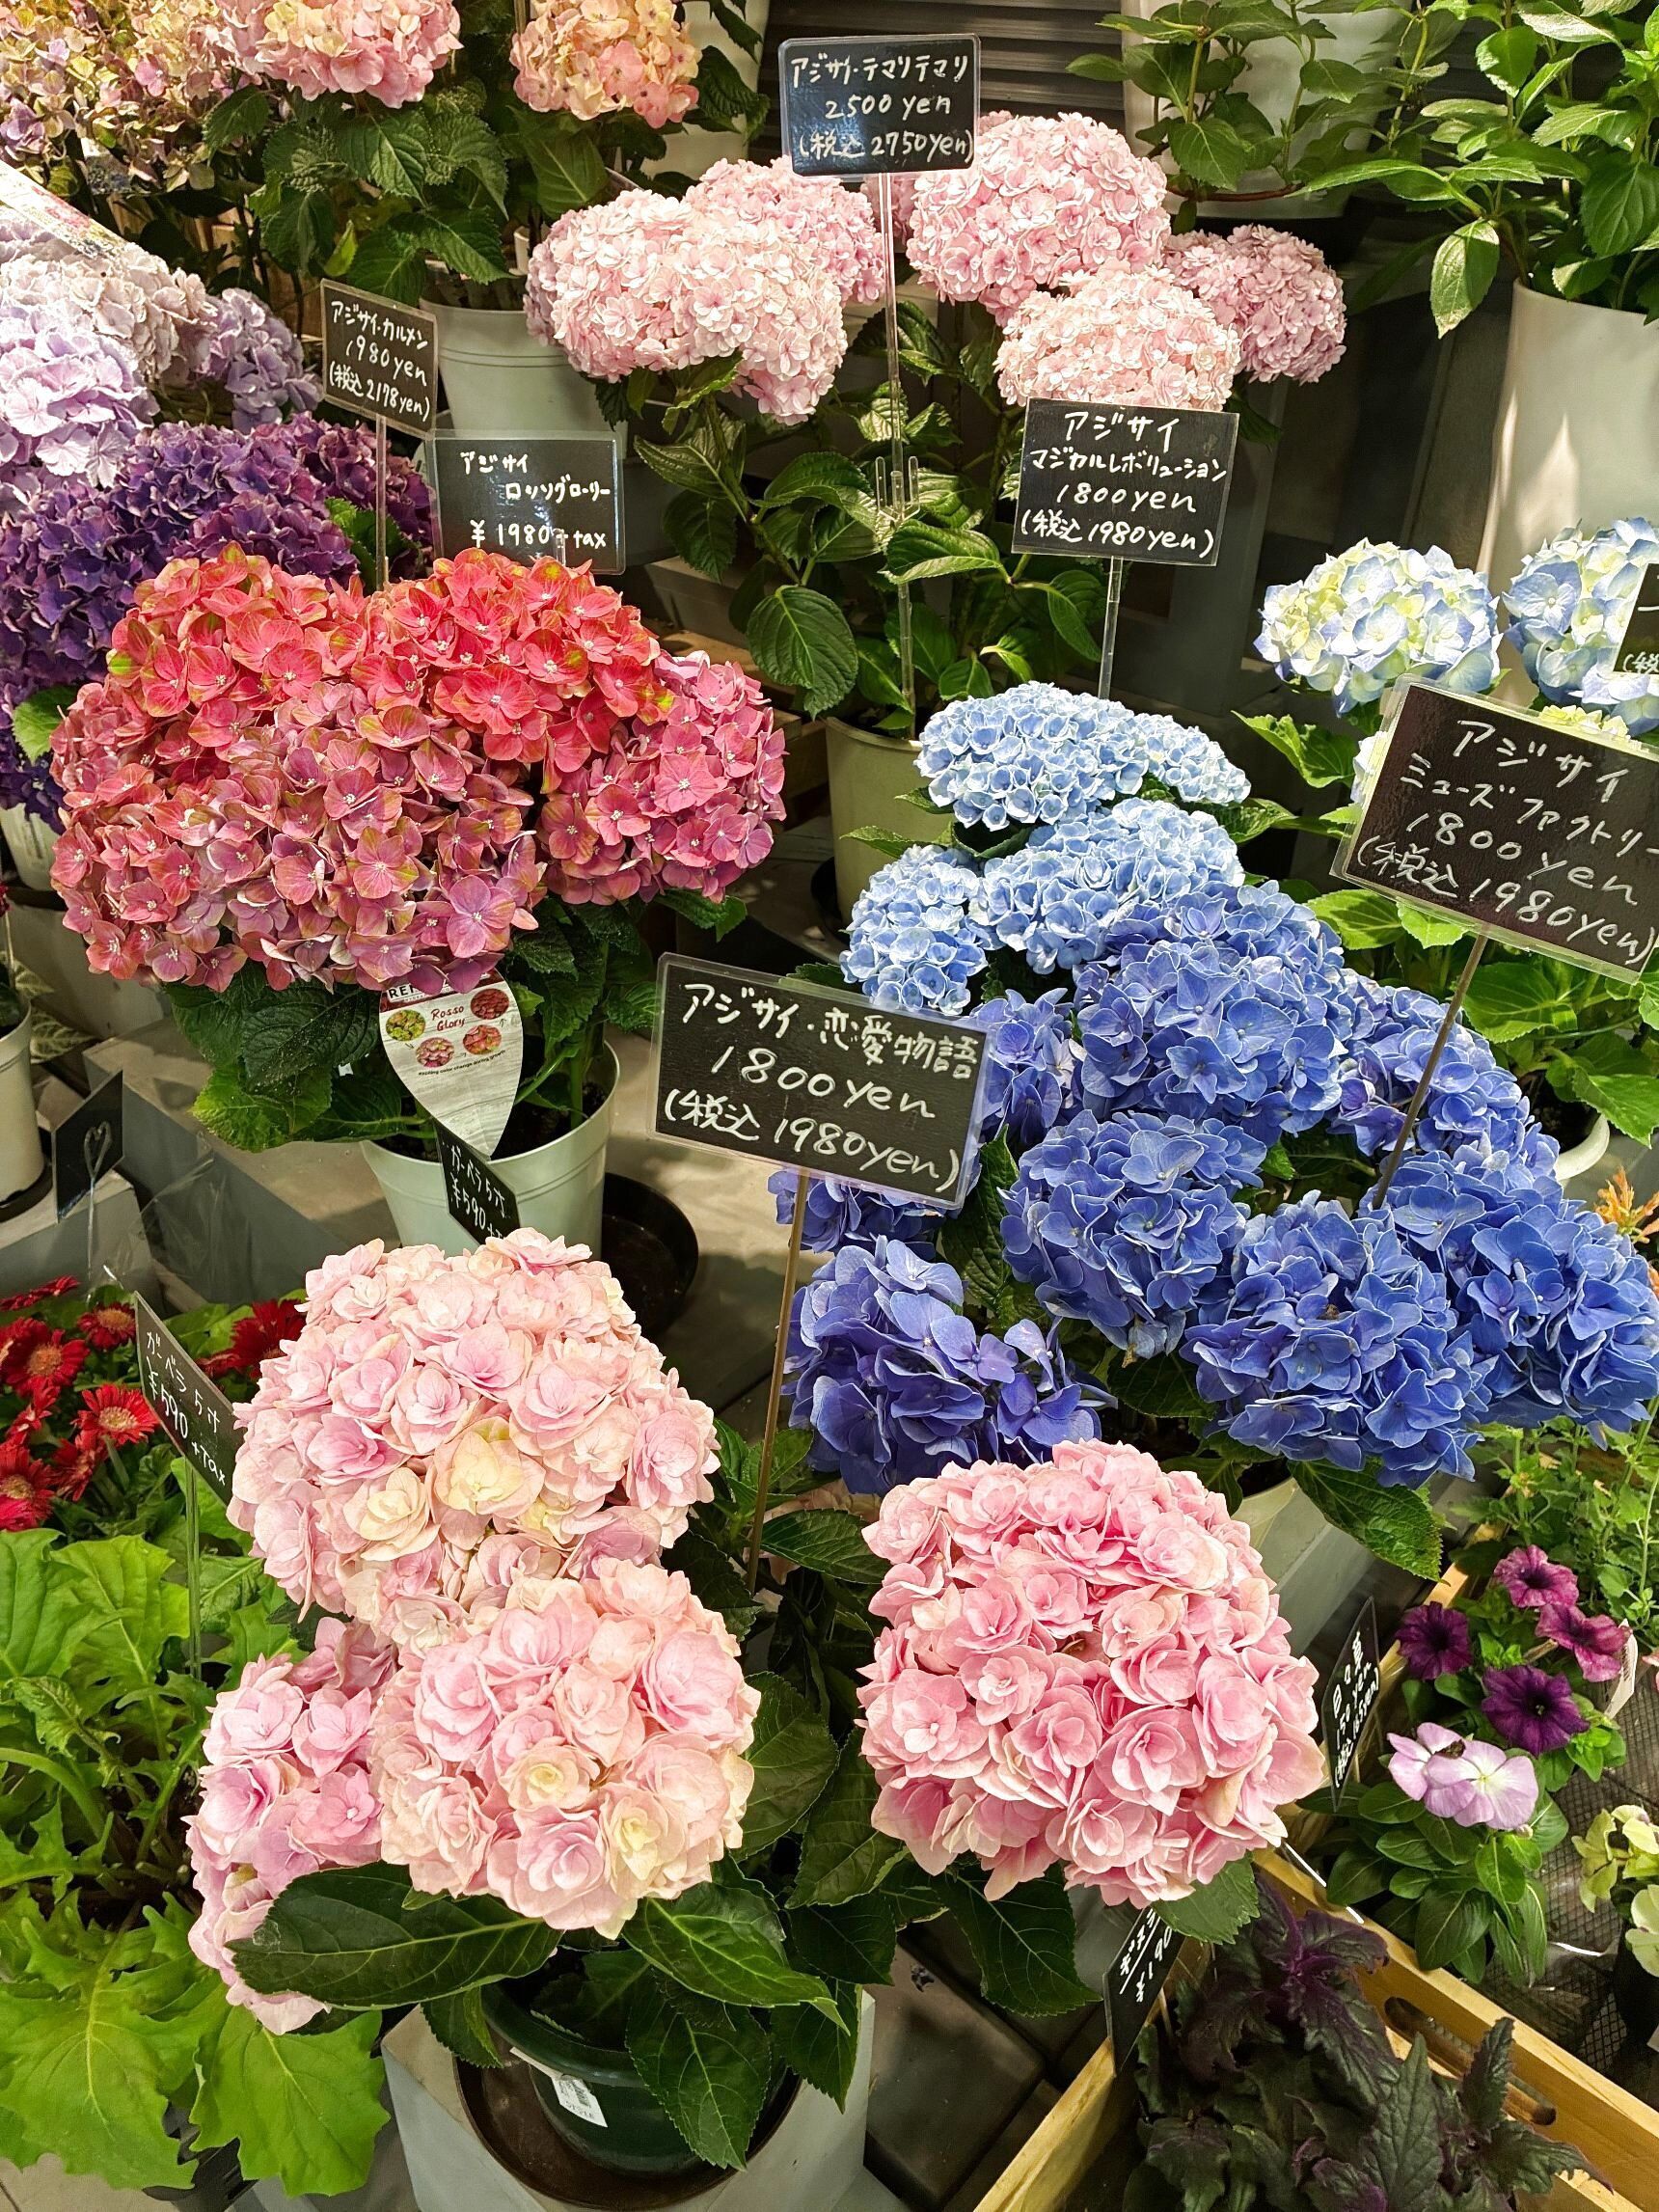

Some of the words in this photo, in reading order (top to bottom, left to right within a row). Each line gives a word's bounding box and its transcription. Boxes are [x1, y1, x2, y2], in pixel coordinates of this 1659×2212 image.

[825, 94, 892, 119] 2500
[902, 96, 951, 121] yen
[1064, 411, 1180, 453] アジサイ
[460, 451, 528, 475] アジサイ
[1030, 446, 1227, 481] マジカルレボリューション
[1453, 721, 1630, 804] アジサイ
[430, 1005, 465, 1021] Rosso
[437, 1018, 466, 1032] Glory
